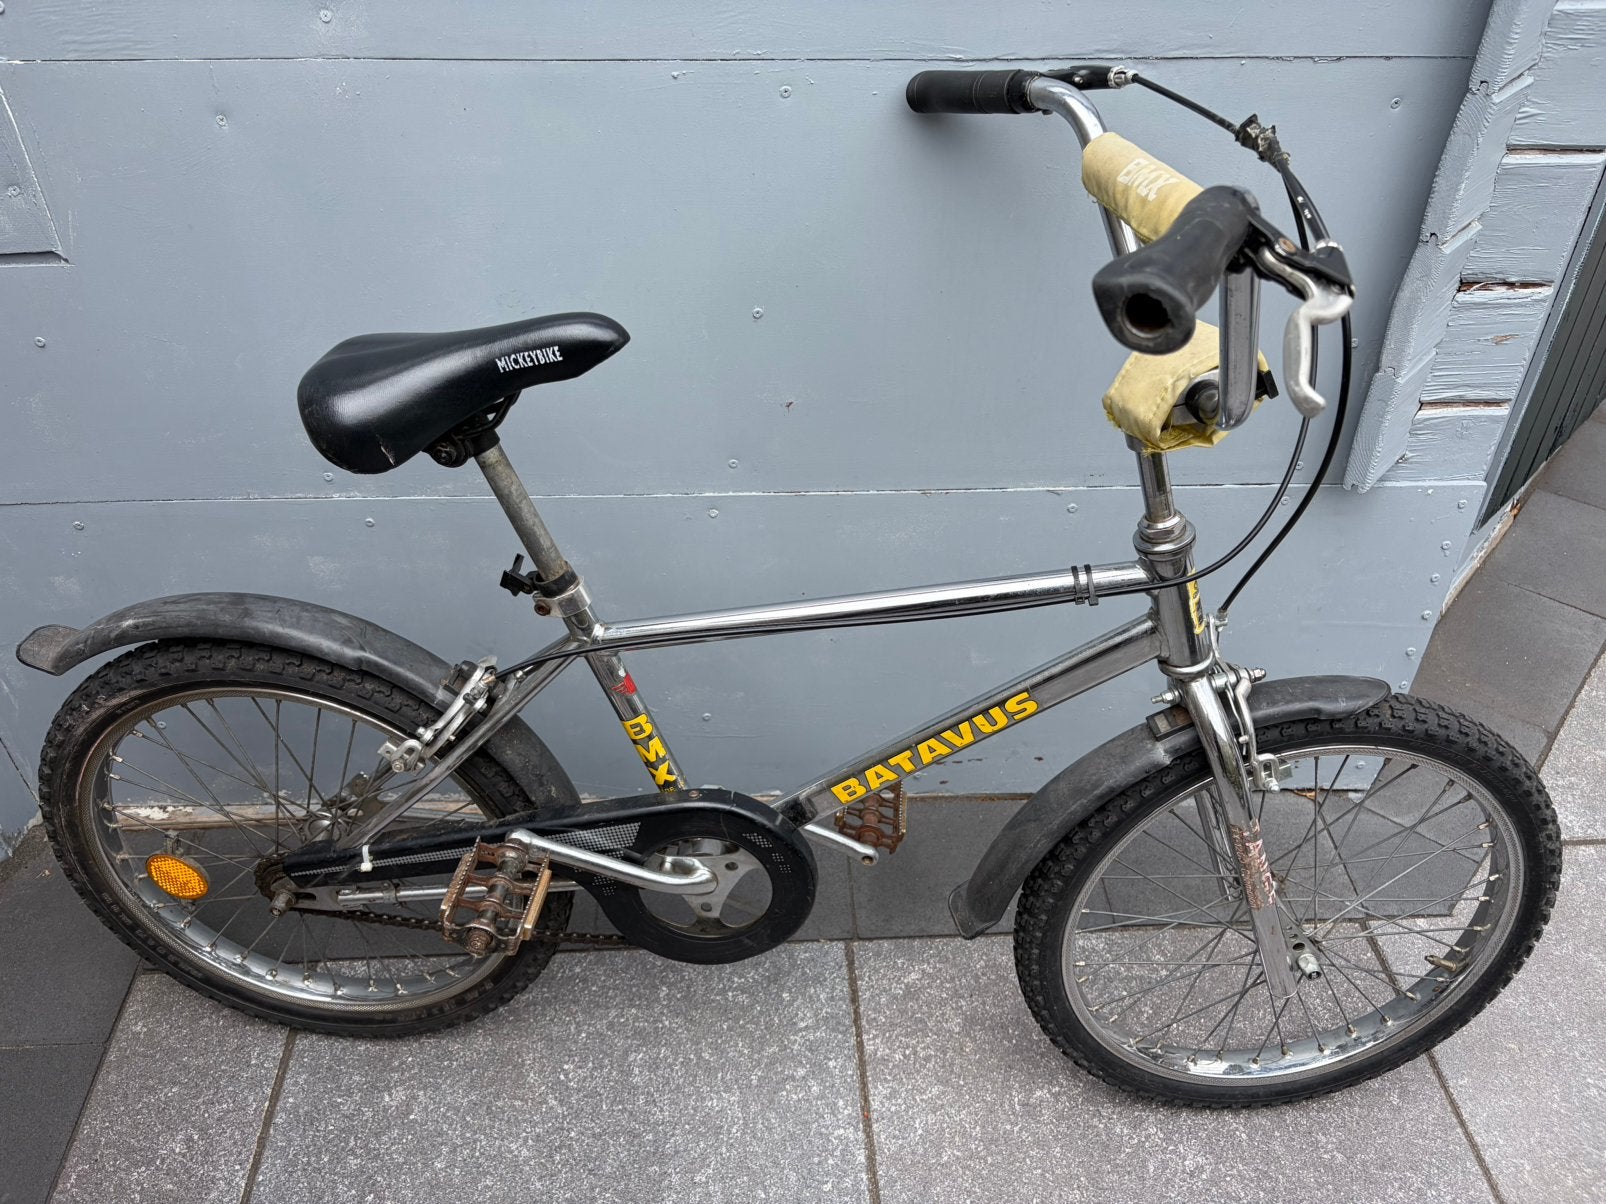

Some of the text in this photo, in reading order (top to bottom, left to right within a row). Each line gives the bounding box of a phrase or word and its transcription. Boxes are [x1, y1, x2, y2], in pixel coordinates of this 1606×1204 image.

[495, 345, 563, 373] MICKEYBIKE
[622, 713, 678, 786] BMX
[831, 691, 1039, 804] BATAVUS
